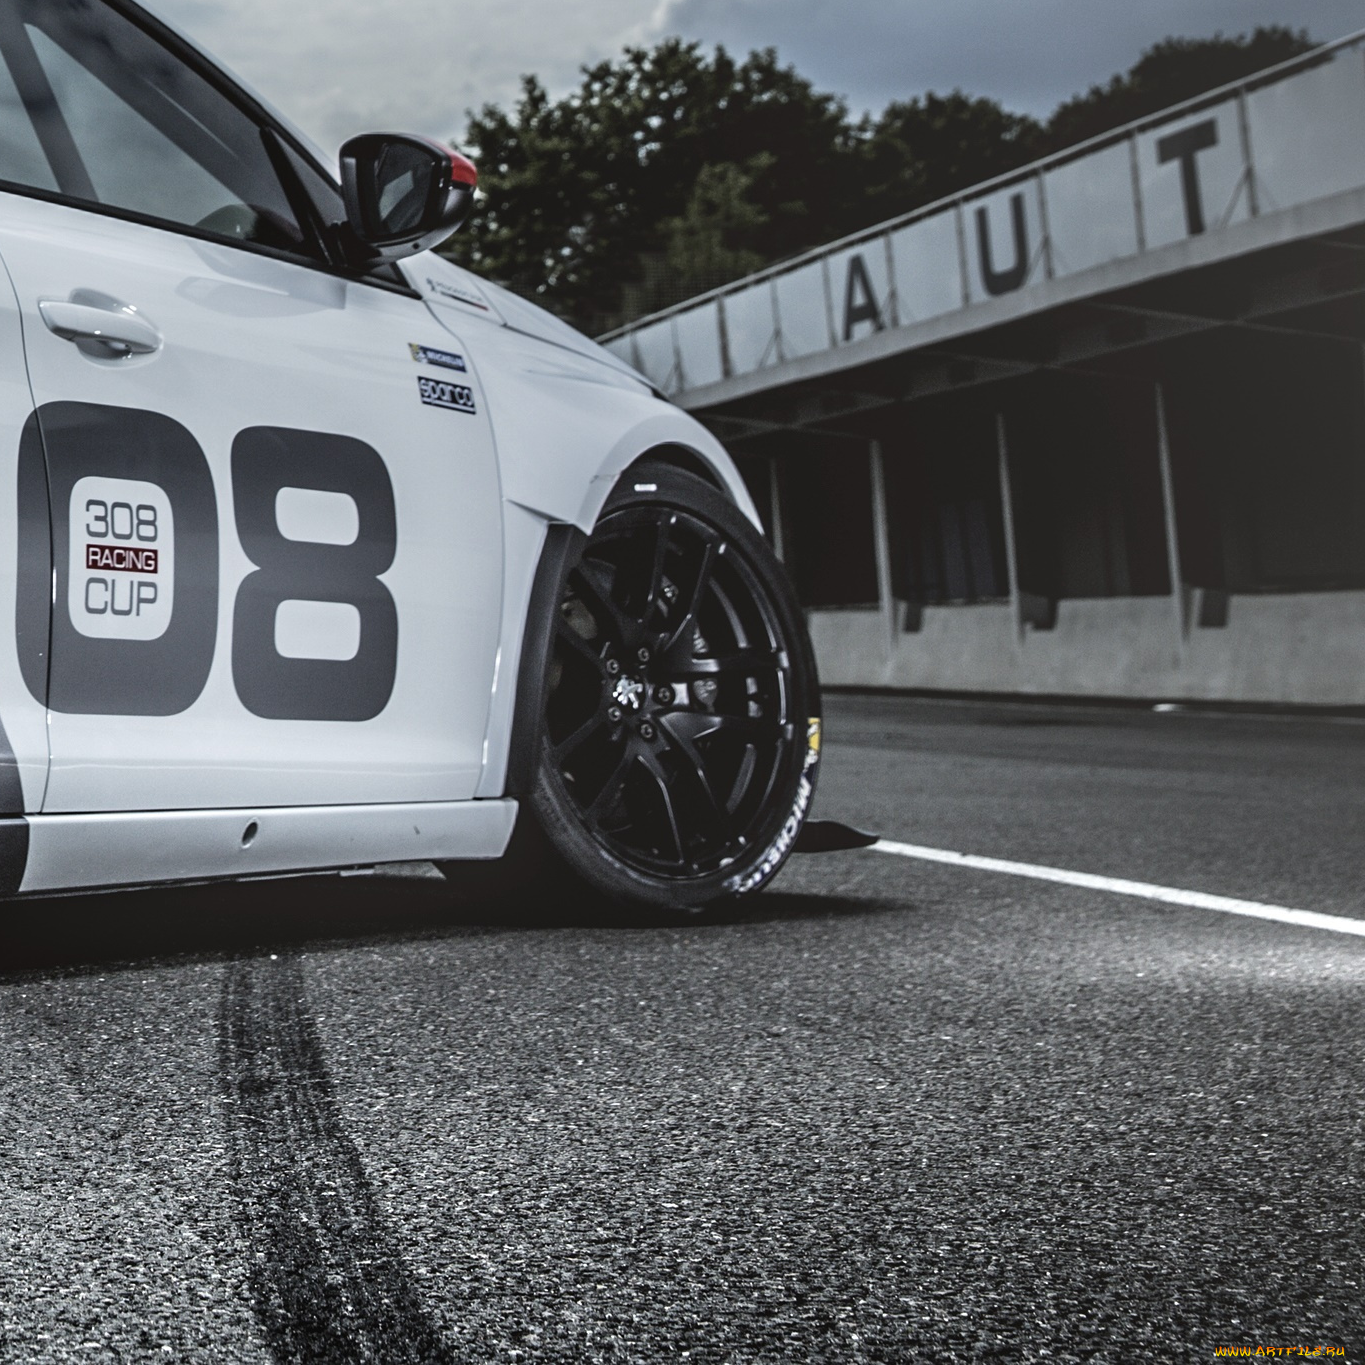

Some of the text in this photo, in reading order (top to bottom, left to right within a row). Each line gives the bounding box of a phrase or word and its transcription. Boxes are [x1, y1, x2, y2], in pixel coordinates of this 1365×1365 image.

[419, 378, 474, 407] sparco
[85, 499, 158, 543] 308
[15, 400, 399, 723] 08
[87, 546, 157, 572] RACING
[84, 577, 158, 617] CUP
